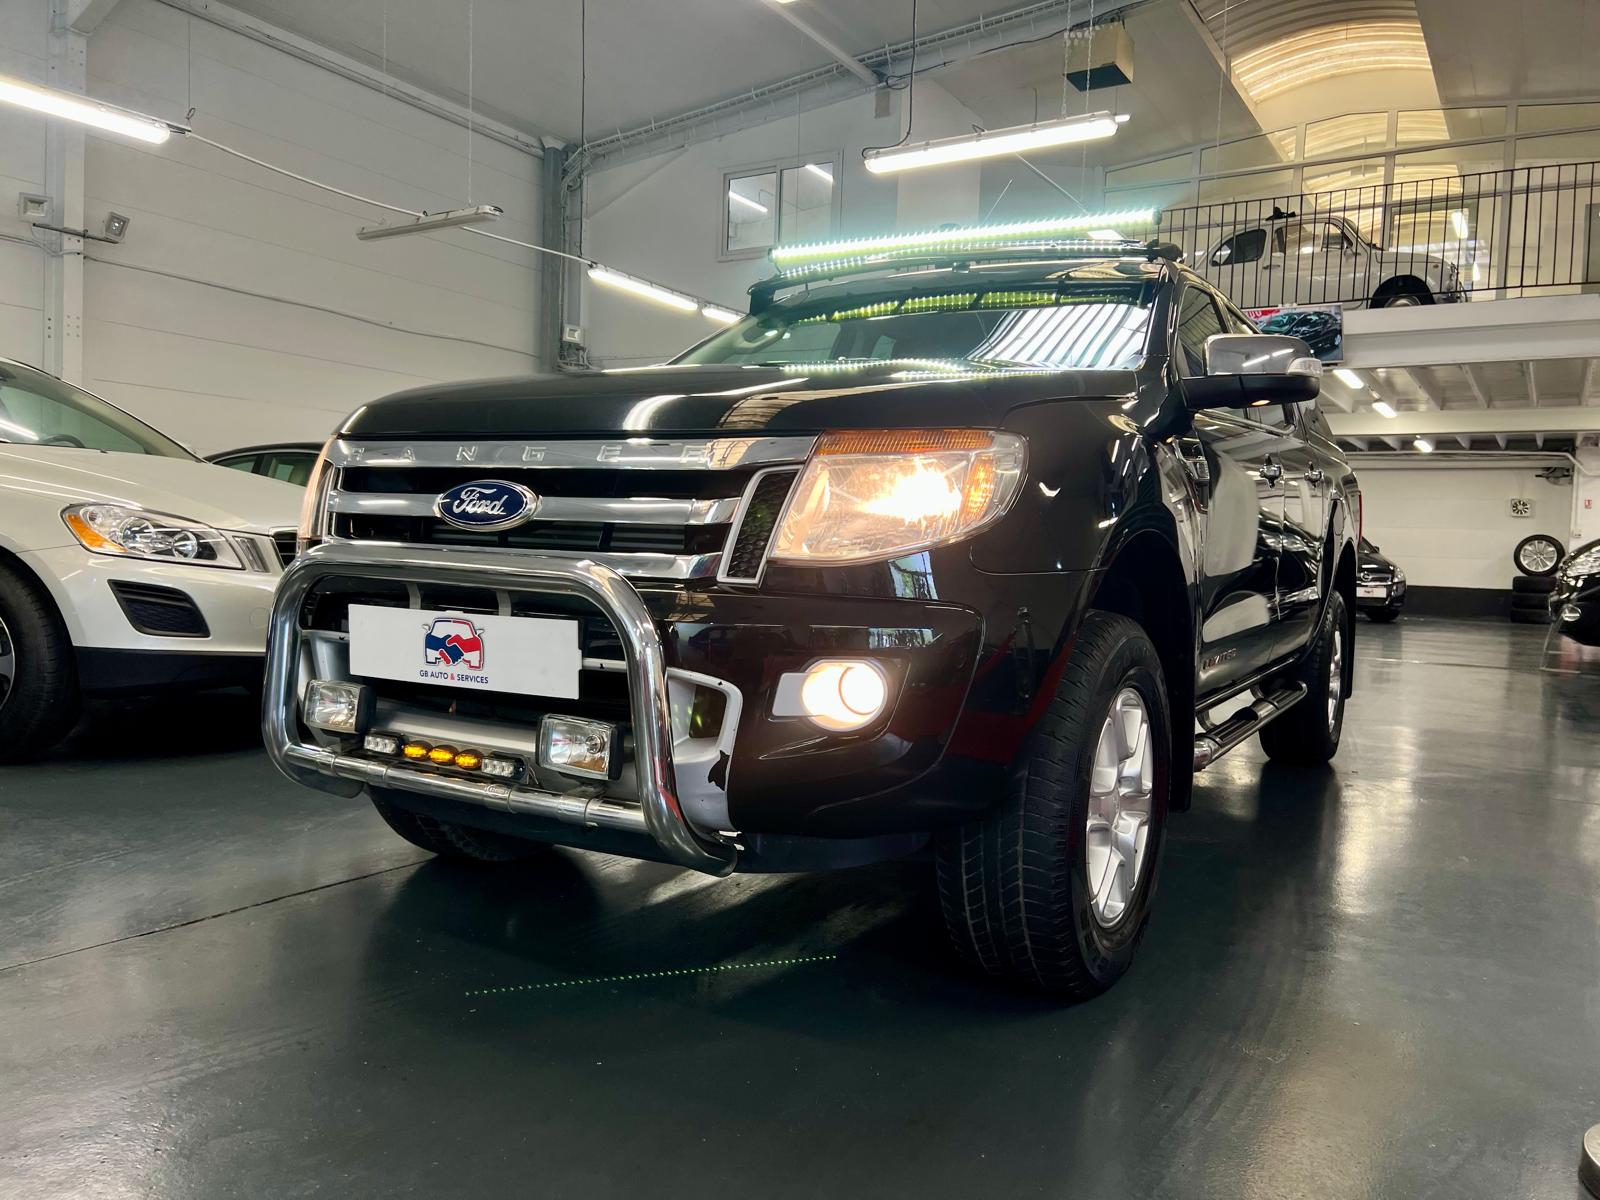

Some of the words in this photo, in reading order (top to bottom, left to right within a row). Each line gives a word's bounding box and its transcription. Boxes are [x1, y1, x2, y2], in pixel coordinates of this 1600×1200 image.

[348, 444, 713, 464] RANGER
[452, 486, 508, 515] Ford
[419, 670, 429, 678] GB
[430, 671, 449, 680] AUTO
[450, 673, 455, 681] &
[457, 673, 489, 684] SERVICES
